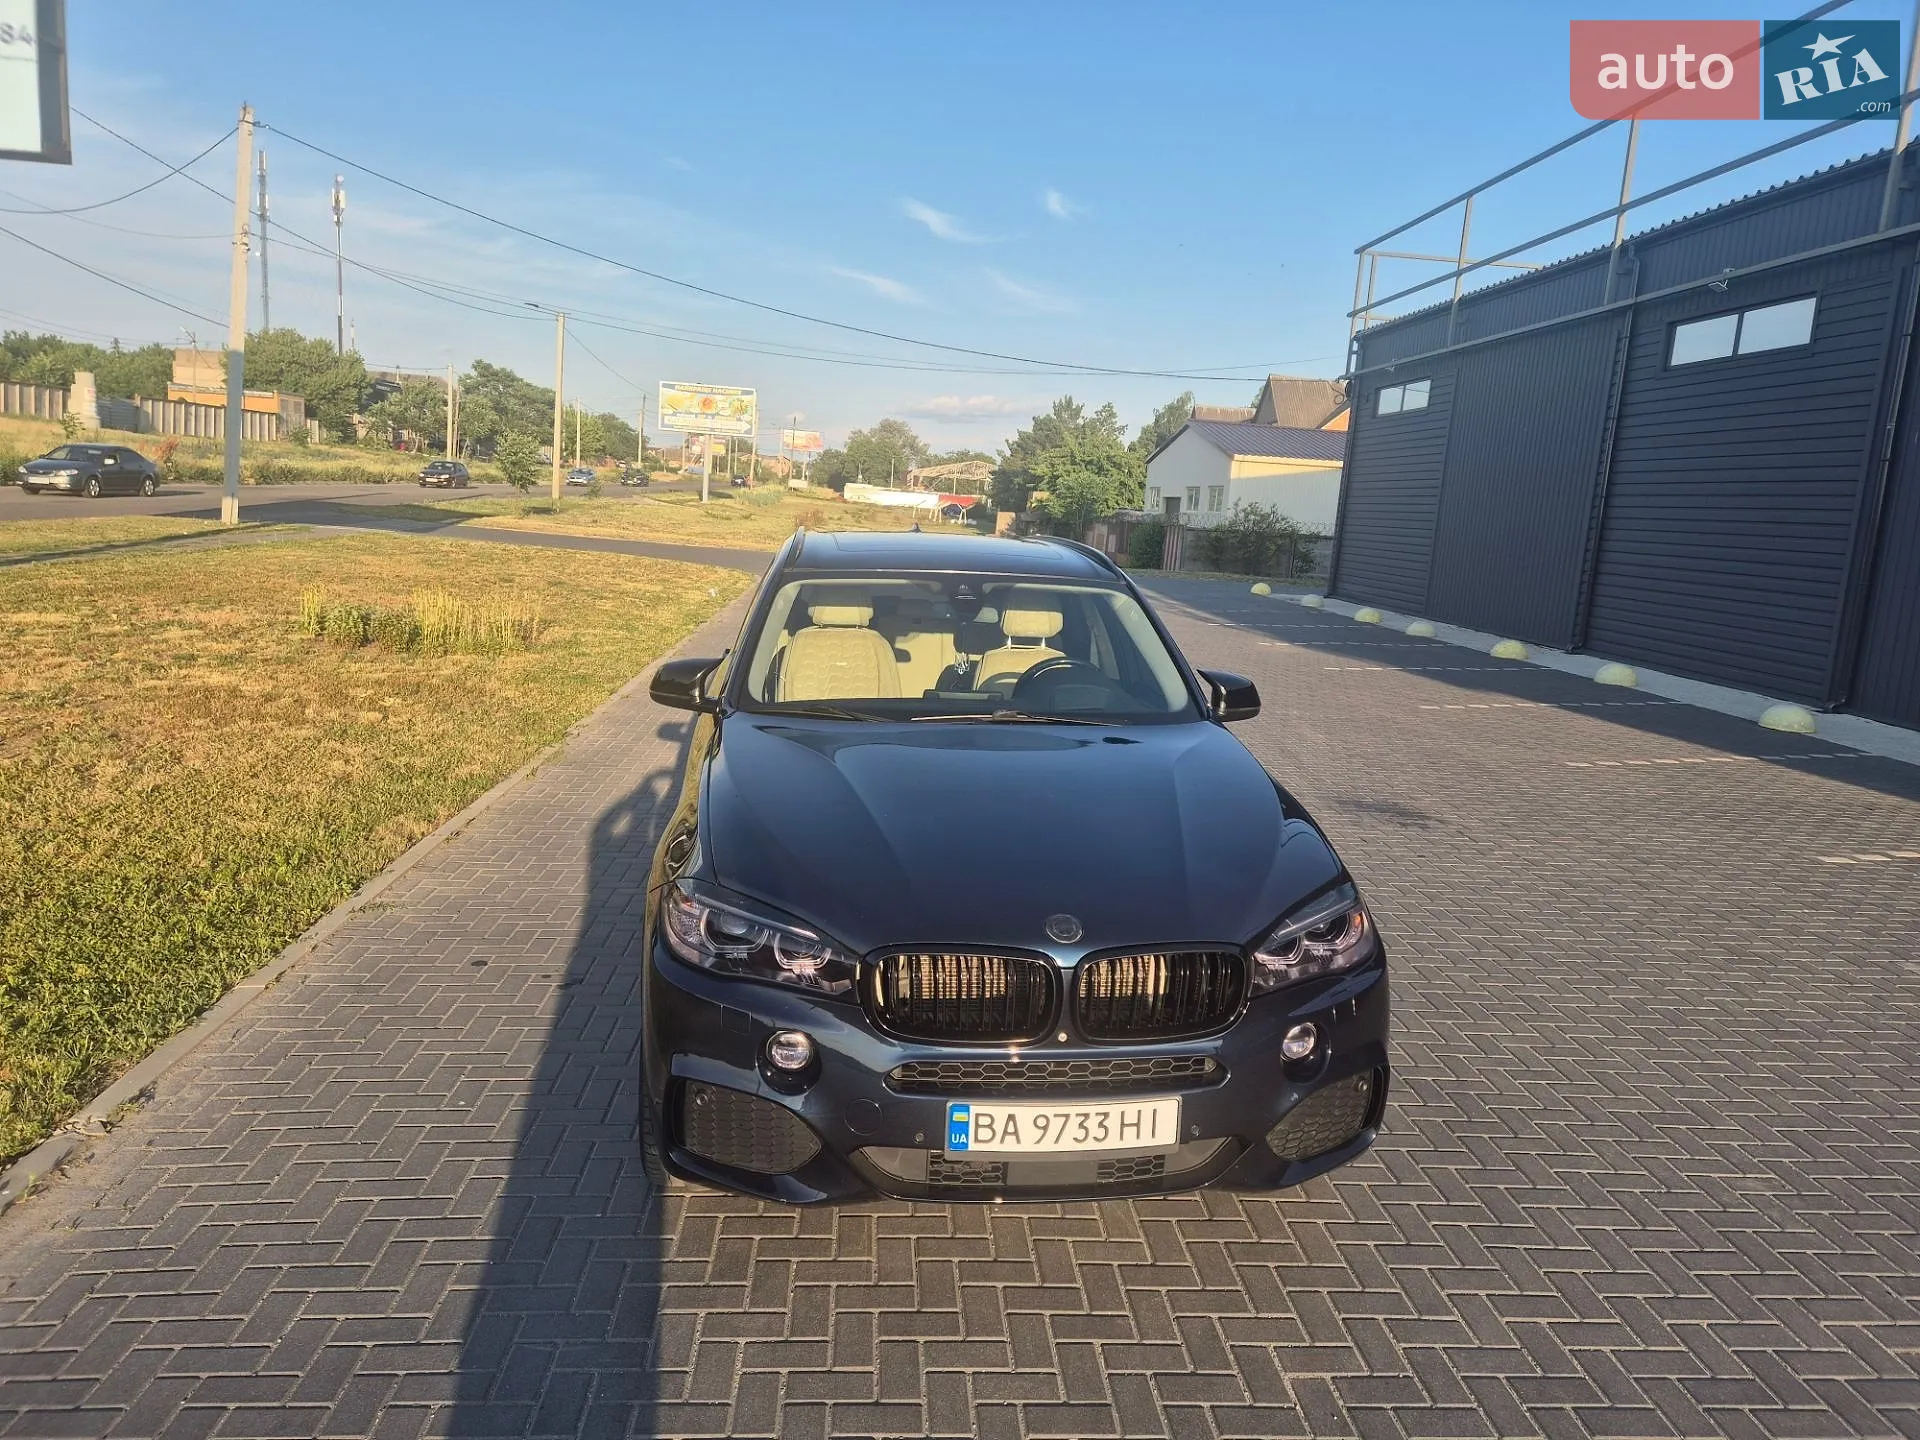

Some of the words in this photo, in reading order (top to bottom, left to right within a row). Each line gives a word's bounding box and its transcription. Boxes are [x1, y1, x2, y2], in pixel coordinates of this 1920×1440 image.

[951, 1132, 968, 1144] UA
[973, 1112, 1022, 1145] BA
[1033, 1112, 1110, 1145] 9733
